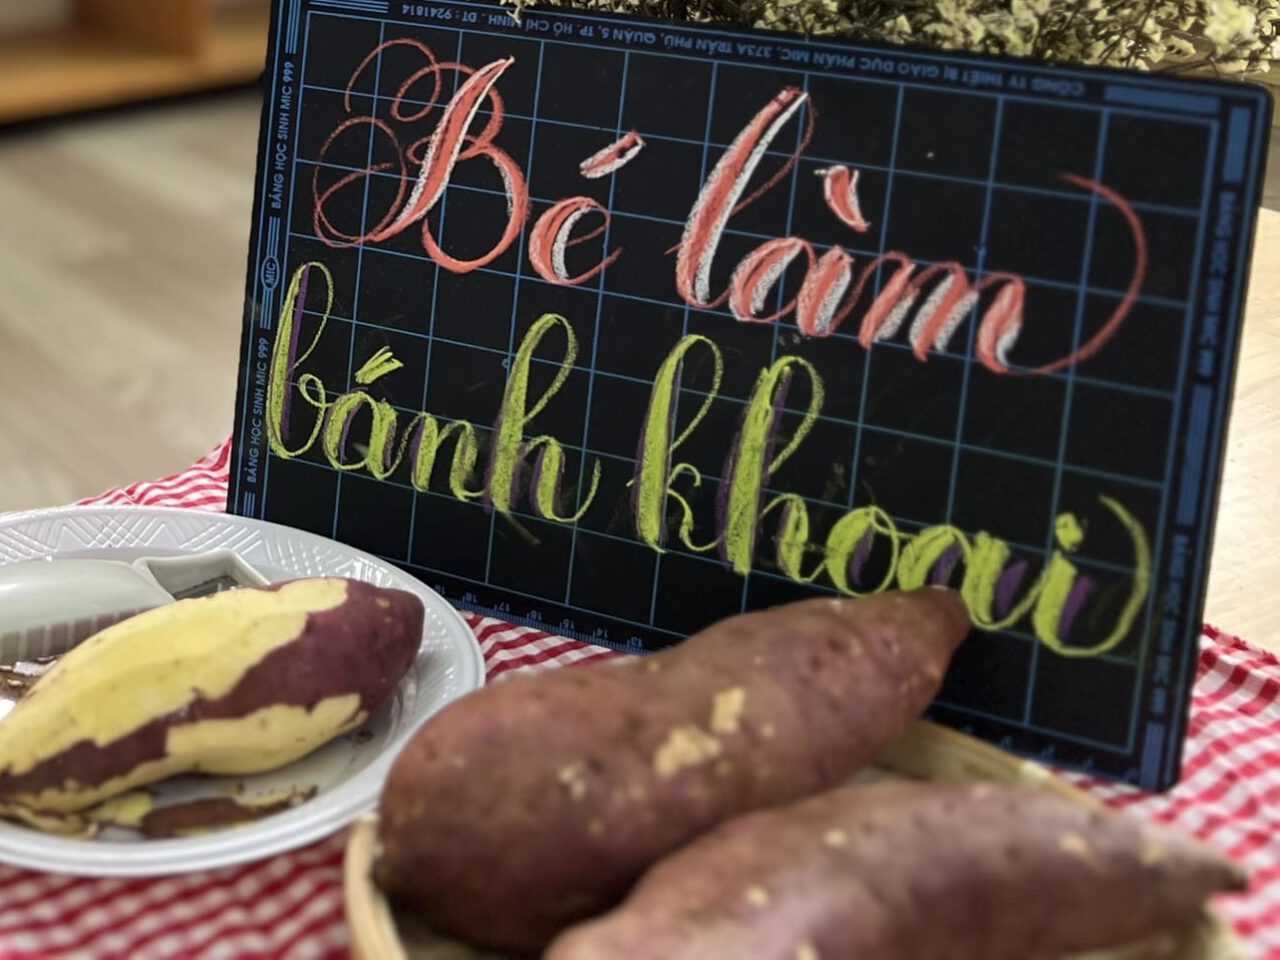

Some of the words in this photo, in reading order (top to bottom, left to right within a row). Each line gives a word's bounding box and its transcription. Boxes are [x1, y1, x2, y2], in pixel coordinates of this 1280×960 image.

[402, 4, 453, 20] 9241814
[525, 19, 550, 32] CHÍ
[612, 27, 656, 44] QUẬN
[736, 42, 773, 58] 373A
[283, 61, 294, 83] 999
[859, 57, 895, 73] DỤC
[281, 86, 292, 110] MIC
[278, 113, 290, 140] SINH
[274, 143, 288, 171] HỌC
[268, 173, 285, 209] BẢNG
[313, 38, 646, 286] Bé
[665, 86, 1147, 375] làm
[264, 261, 277, 285] MIC
[259, 338, 270, 359] 999
[256, 362, 268, 385] MIC
[254, 388, 265, 416] SINH
[250, 417, 262, 445] HỌC
[245, 448, 260, 484] BẢNG
[265, 261, 602, 523] bánh
[626, 334, 1150, 657] khoai
